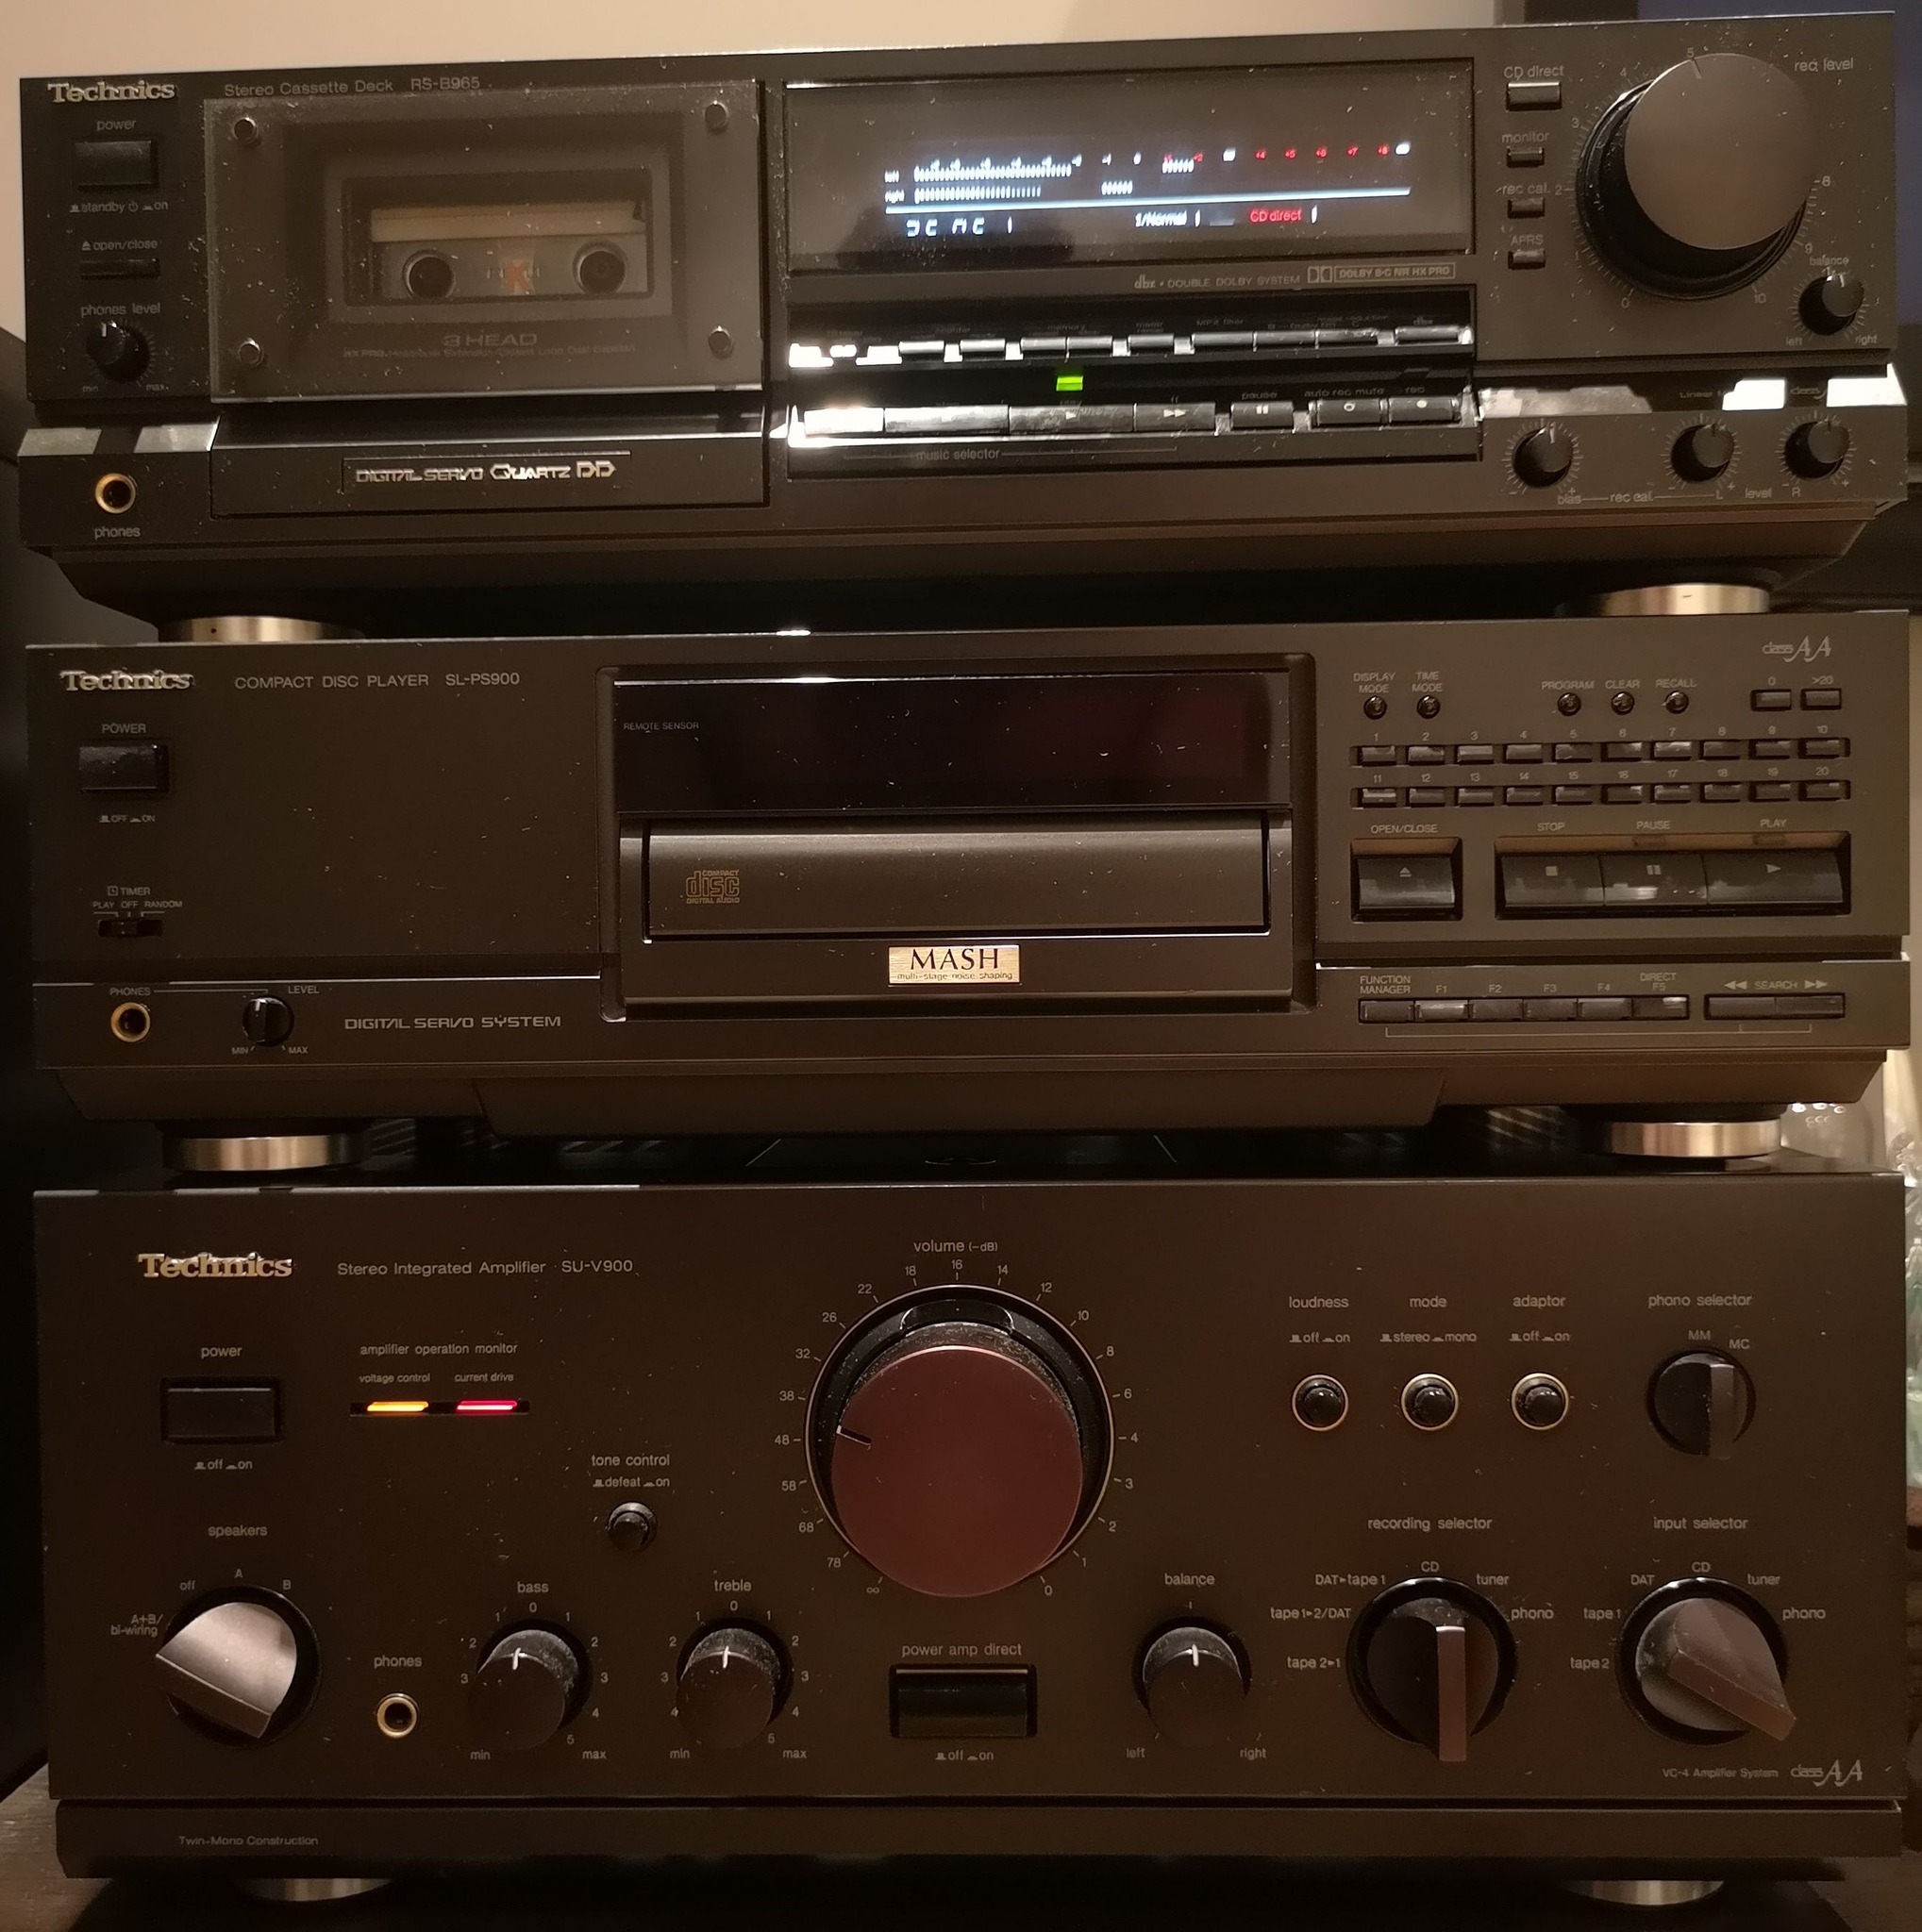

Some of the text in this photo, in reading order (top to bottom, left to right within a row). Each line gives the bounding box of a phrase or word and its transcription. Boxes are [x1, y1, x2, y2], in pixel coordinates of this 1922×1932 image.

[1503, 64, 1564, 79] CD direct
[1794, 58, 1854, 73] rec level
[48, 80, 176, 103] Technics
[225, 75, 480, 97] Stereo Cassette Deck RS-B965
[96, 120, 136, 131] power
[1501, 131, 1549, 144] monitor
[81, 201, 168, 213] standby on
[1250, 208, 1302, 223] CD direct
[93, 240, 158, 251] open/close
[1510, 233, 1544, 246] APRS
[1339, 268, 1373, 279] DOLBY
[1412, 266, 1427, 276] HX
[1428, 265, 1450, 276] PRO
[1134, 275, 1300, 289] dbx DOUBLE DOLBY SYSTEM
[80, 303, 160, 318] phones level
[465, 334, 537, 347] HEAD
[916, 448, 1000, 461] music selector
[356, 460, 616, 482] DIGITAL SERVO QUARTZ DD
[1745, 486, 1772, 499] level
[94, 525, 141, 541] phones
[59, 669, 195, 691] Technics
[235, 673, 520, 690] COMPACT DISC PLAYER SL-PS900
[1353, 673, 1396, 683] DISPLAY
[1415, 672, 1440, 681] TIME
[1359, 683, 1391, 693] MODE
[1412, 683, 1444, 693] MODE
[1541, 680, 1595, 691] PROGRAM
[1605, 679, 1641, 690] CLEAR
[1655, 678, 1696, 689] RECALL
[101, 723, 147, 735] POWER
[623, 720, 700, 731] REMOTE SENSOR
[1537, 823, 1565, 832] STOP
[1636, 821, 1672, 830] PAUSE
[1760, 818, 1788, 828] PLAY
[1371, 824, 1439, 835] OPEN/CLOSE
[686, 871, 741, 898] disc
[120, 886, 151, 897] TIMER
[911, 948, 998, 971] MASH
[897, 972, 948, 982] multi-stage
[979, 971, 1012, 981] shaping
[1360, 975, 1412, 985] FUNCTION
[1639, 973, 1677, 982] DIRECT
[288, 985, 321, 995] LEVEL
[1360, 985, 1412, 995] MANAGER
[1753, 979, 1797, 991] SEARCH
[109, 986, 152, 997] PHONES
[344, 1014, 561, 1030] DIGITAL SERVO SYSTEM
[913, 1239, 998, 1254] volume (-dB)
[138, 1252, 293, 1279] Technics
[337, 1259, 633, 1278] Stereo Integrated Amplifier SU-V900
[905, 1265, 916, 1275] 18
[951, 1259, 962, 1270] 16
[996, 1265, 1009, 1275] 14
[858, 1283, 873, 1294] 22
[1041, 1282, 1053, 1293] 12
[1288, 1295, 1349, 1309] loudness
[1410, 1295, 1447, 1308] mode
[1513, 1294, 1567, 1310] adaptor
[1647, 1292, 1753, 1309] phono selector
[822, 1312, 838, 1323] 26
[1078, 1310, 1089, 1322] 10
[1393, 1331, 1478, 1343] stereo mono
[1522, 1331, 1571, 1343] off on
[1688, 1330, 1712, 1341] MM
[359, 1342, 518, 1357] amplifier operation monitor
[1729, 1339, 1750, 1350] MC
[200, 1345, 242, 1359] power
[795, 1348, 811, 1359] 32
[359, 1373, 431, 1385] voltage control
[454, 1373, 514, 1383] current drive
[778, 1391, 795, 1401] 38
[774, 1435, 790, 1446] 48
[208, 1459, 253, 1471] off on
[592, 1453, 670, 1467] tone control
[605, 1475, 671, 1488] defeat on
[781, 1480, 796, 1491] 58
[798, 1522, 814, 1533] 68
[1368, 1516, 1493, 1532] recording selector
[1653, 1516, 1748, 1531] input selector
[208, 1524, 268, 1538] speakers
[827, 1557, 842, 1568] 78
[1420, 1561, 1440, 1573] CD
[1691, 1561, 1711, 1573] CD
[179, 1579, 196, 1591] off
[714, 1579, 752, 1592] treble
[1163, 1573, 1215, 1587] balance
[1477, 1573, 1510, 1587] tuner
[1630, 1574, 1654, 1586] DAT
[1747, 1574, 1780, 1586] tuner
[517, 1580, 549, 1593] bass
[131, 1614, 163, 1626] A+B/
[1511, 1607, 1554, 1623] phono
[1782, 1607, 1826, 1622] phono
[110, 1624, 159, 1638] bi-wiring
[901, 1642, 1023, 1657] power amp direct
[374, 1655, 423, 1670] phones
[471, 1748, 491, 1760] min
[582, 1750, 607, 1759] max
[670, 1747, 690, 1759] min
[782, 1749, 807, 1759] max
[947, 1749, 994, 1761] off on
[1126, 1747, 1145, 1759] left
[1239, 1747, 1267, 1761] right
[1663, 1767, 1779, 1779] VC-4 Amplifier System
[178, 1835, 319, 1846] Twin-Mono Construction
